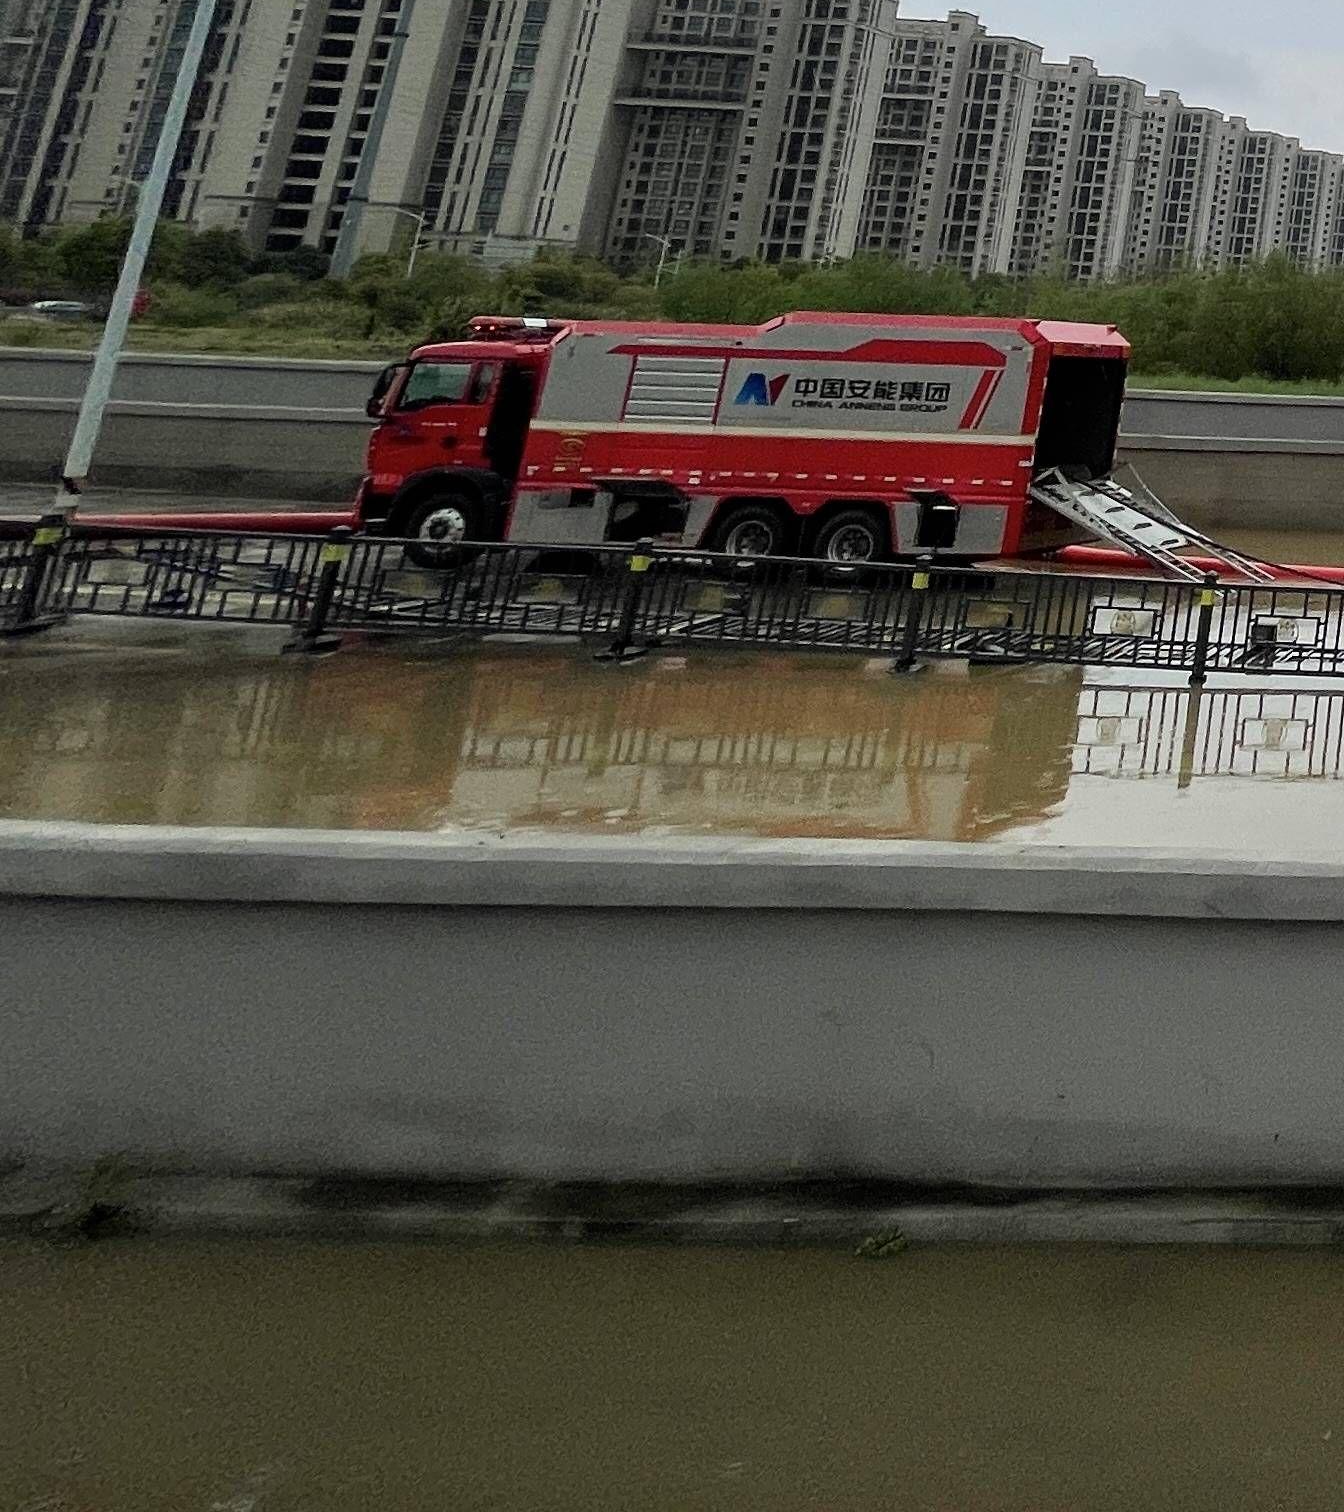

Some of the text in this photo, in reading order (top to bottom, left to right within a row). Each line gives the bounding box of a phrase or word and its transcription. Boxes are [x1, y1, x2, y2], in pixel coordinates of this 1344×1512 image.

[794, 378, 950, 402] 中国安能集团
[792, 399, 833, 409] CHINA
[899, 403, 948, 413] GROUP
